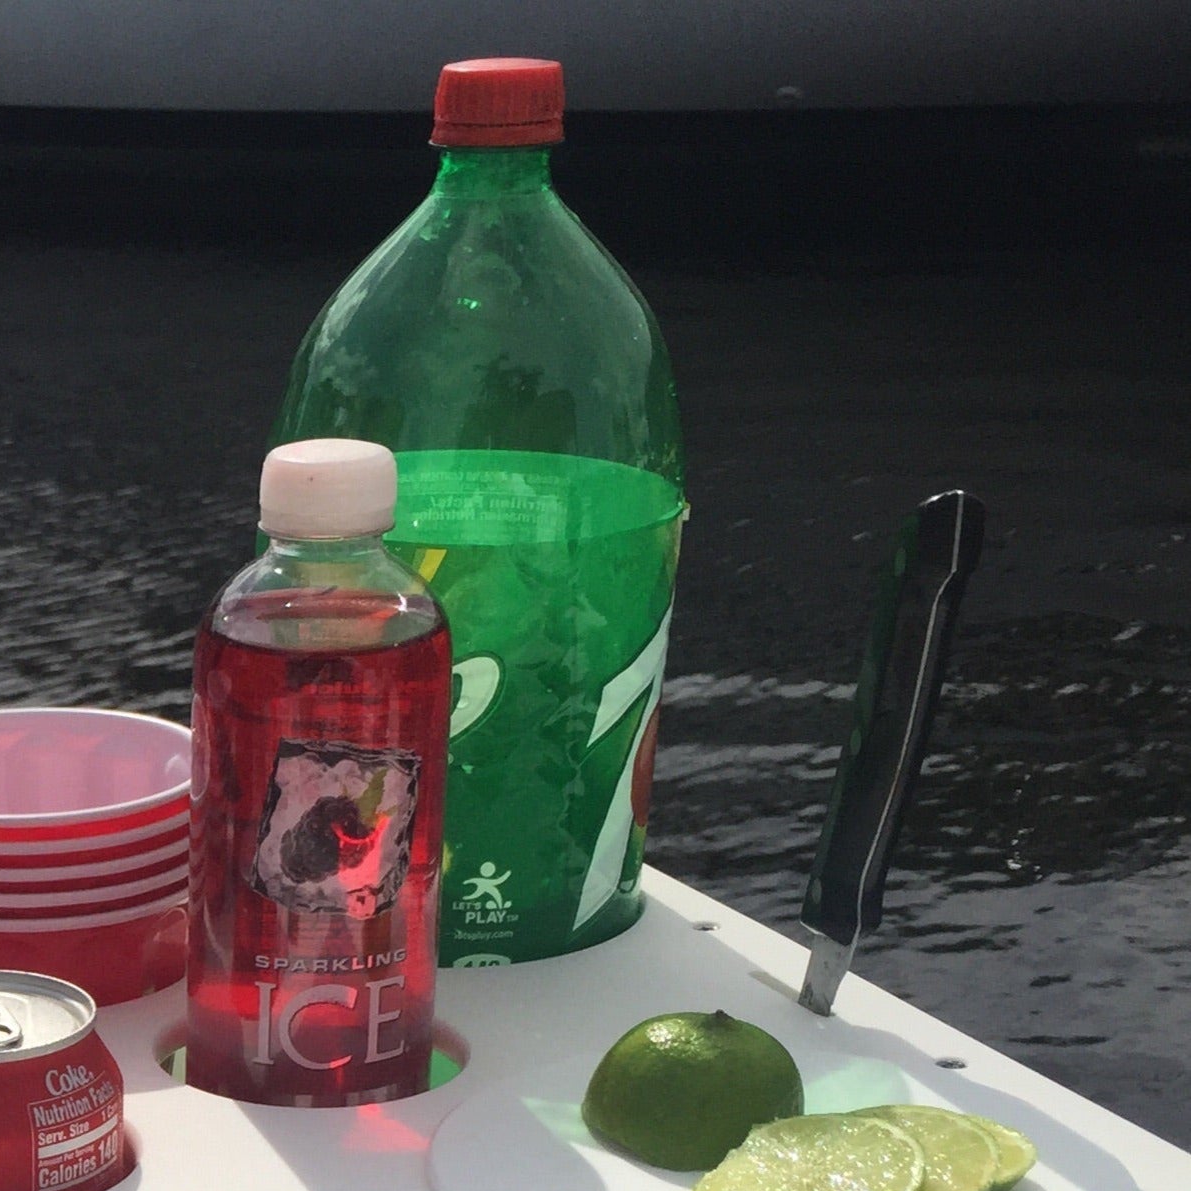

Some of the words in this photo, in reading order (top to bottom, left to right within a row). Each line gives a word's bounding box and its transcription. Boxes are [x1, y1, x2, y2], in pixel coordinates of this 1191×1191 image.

[465, 910, 507, 924] PLAY
[255, 949, 406, 973] SPARKLING
[252, 975, 406, 1071] ICE
[34, 1094, 90, 1127] Nutrition
[38, 1130, 66, 1146] Serv.
[70, 1120, 89, 1138] Size
[39, 1155, 96, 1188] Calories
[99, 1130, 118, 1165] 140
